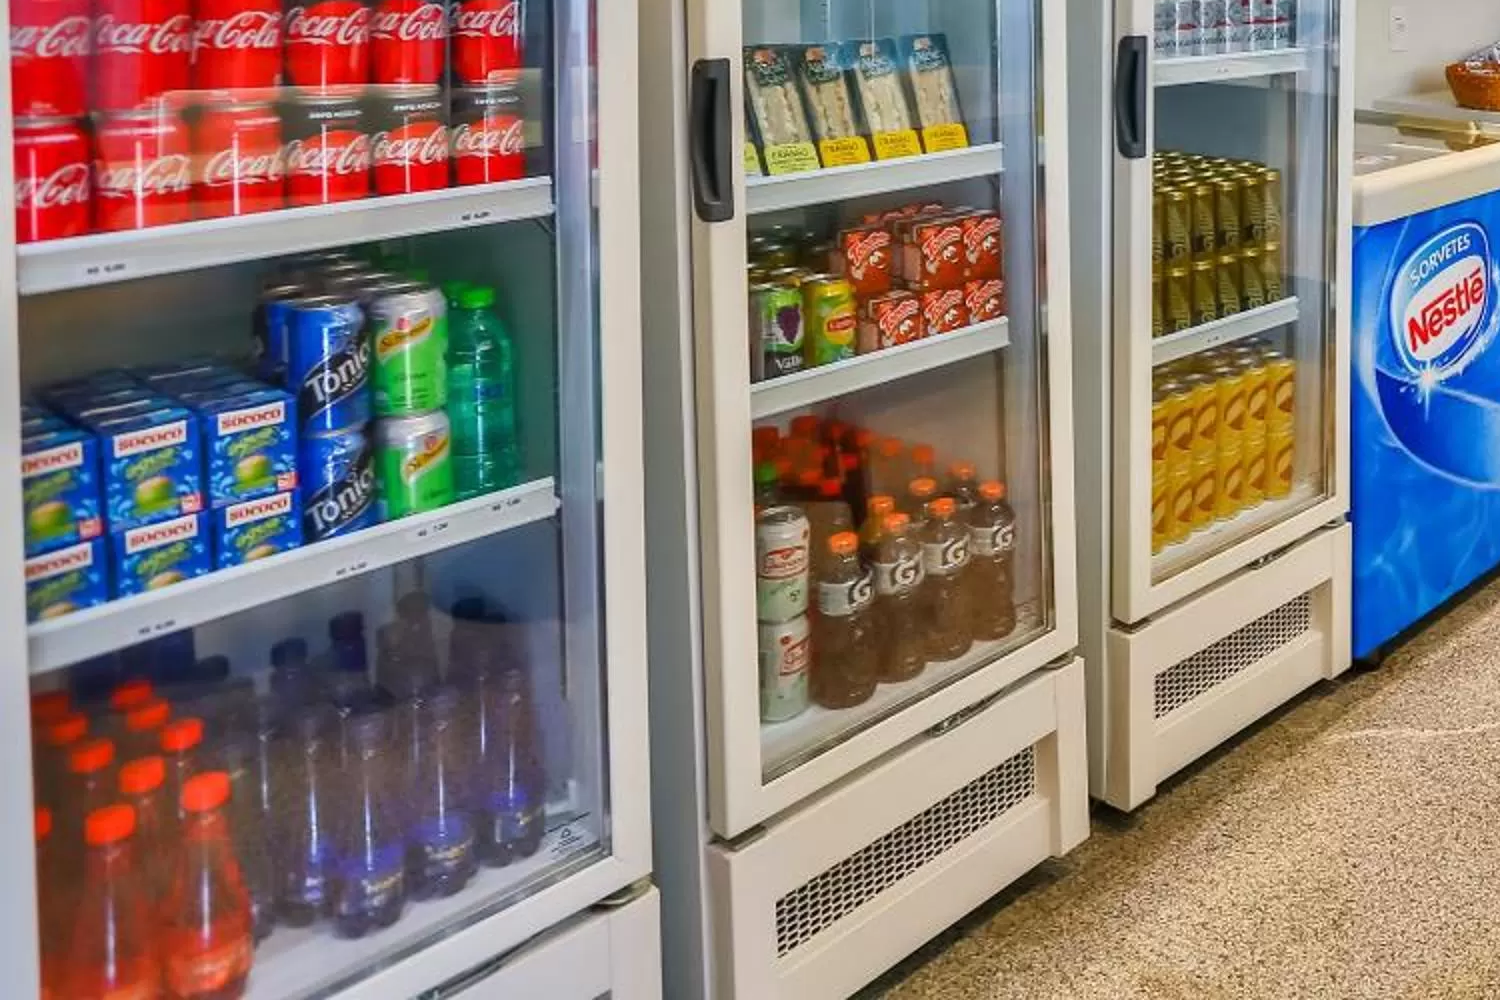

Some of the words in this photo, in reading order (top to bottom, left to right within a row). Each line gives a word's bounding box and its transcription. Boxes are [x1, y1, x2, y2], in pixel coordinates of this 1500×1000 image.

[1411, 233, 1472, 288] SORVETES
[1408, 267, 1484, 353] Nestlé
[22, 448, 79, 474] OCOCO
